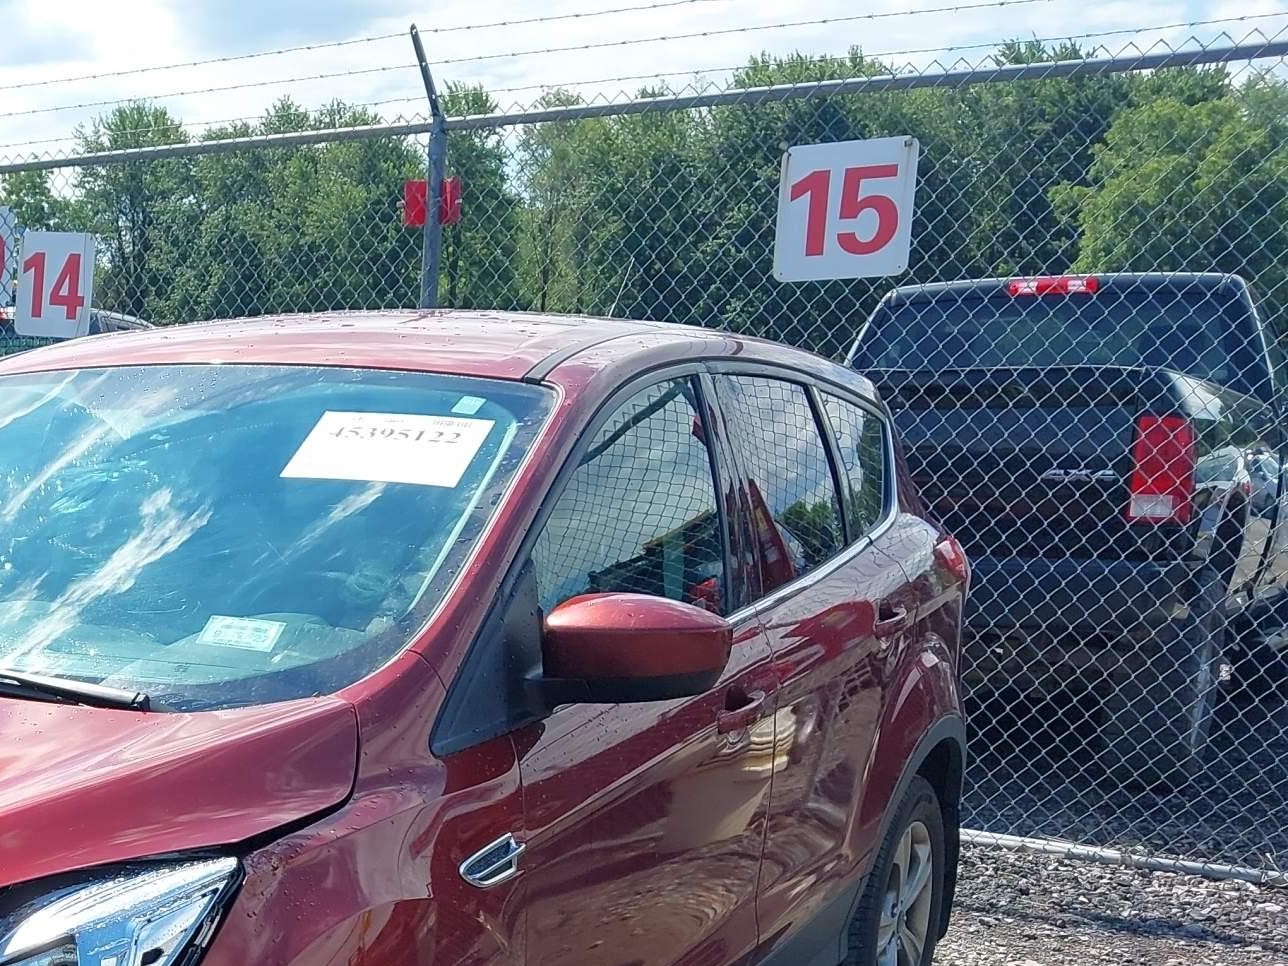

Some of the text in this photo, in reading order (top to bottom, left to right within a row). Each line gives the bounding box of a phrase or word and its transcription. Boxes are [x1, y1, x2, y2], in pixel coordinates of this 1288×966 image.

[790, 163, 899, 256] 15
[23, 251, 85, 320] 14
[328, 425, 462, 444] 45395122
